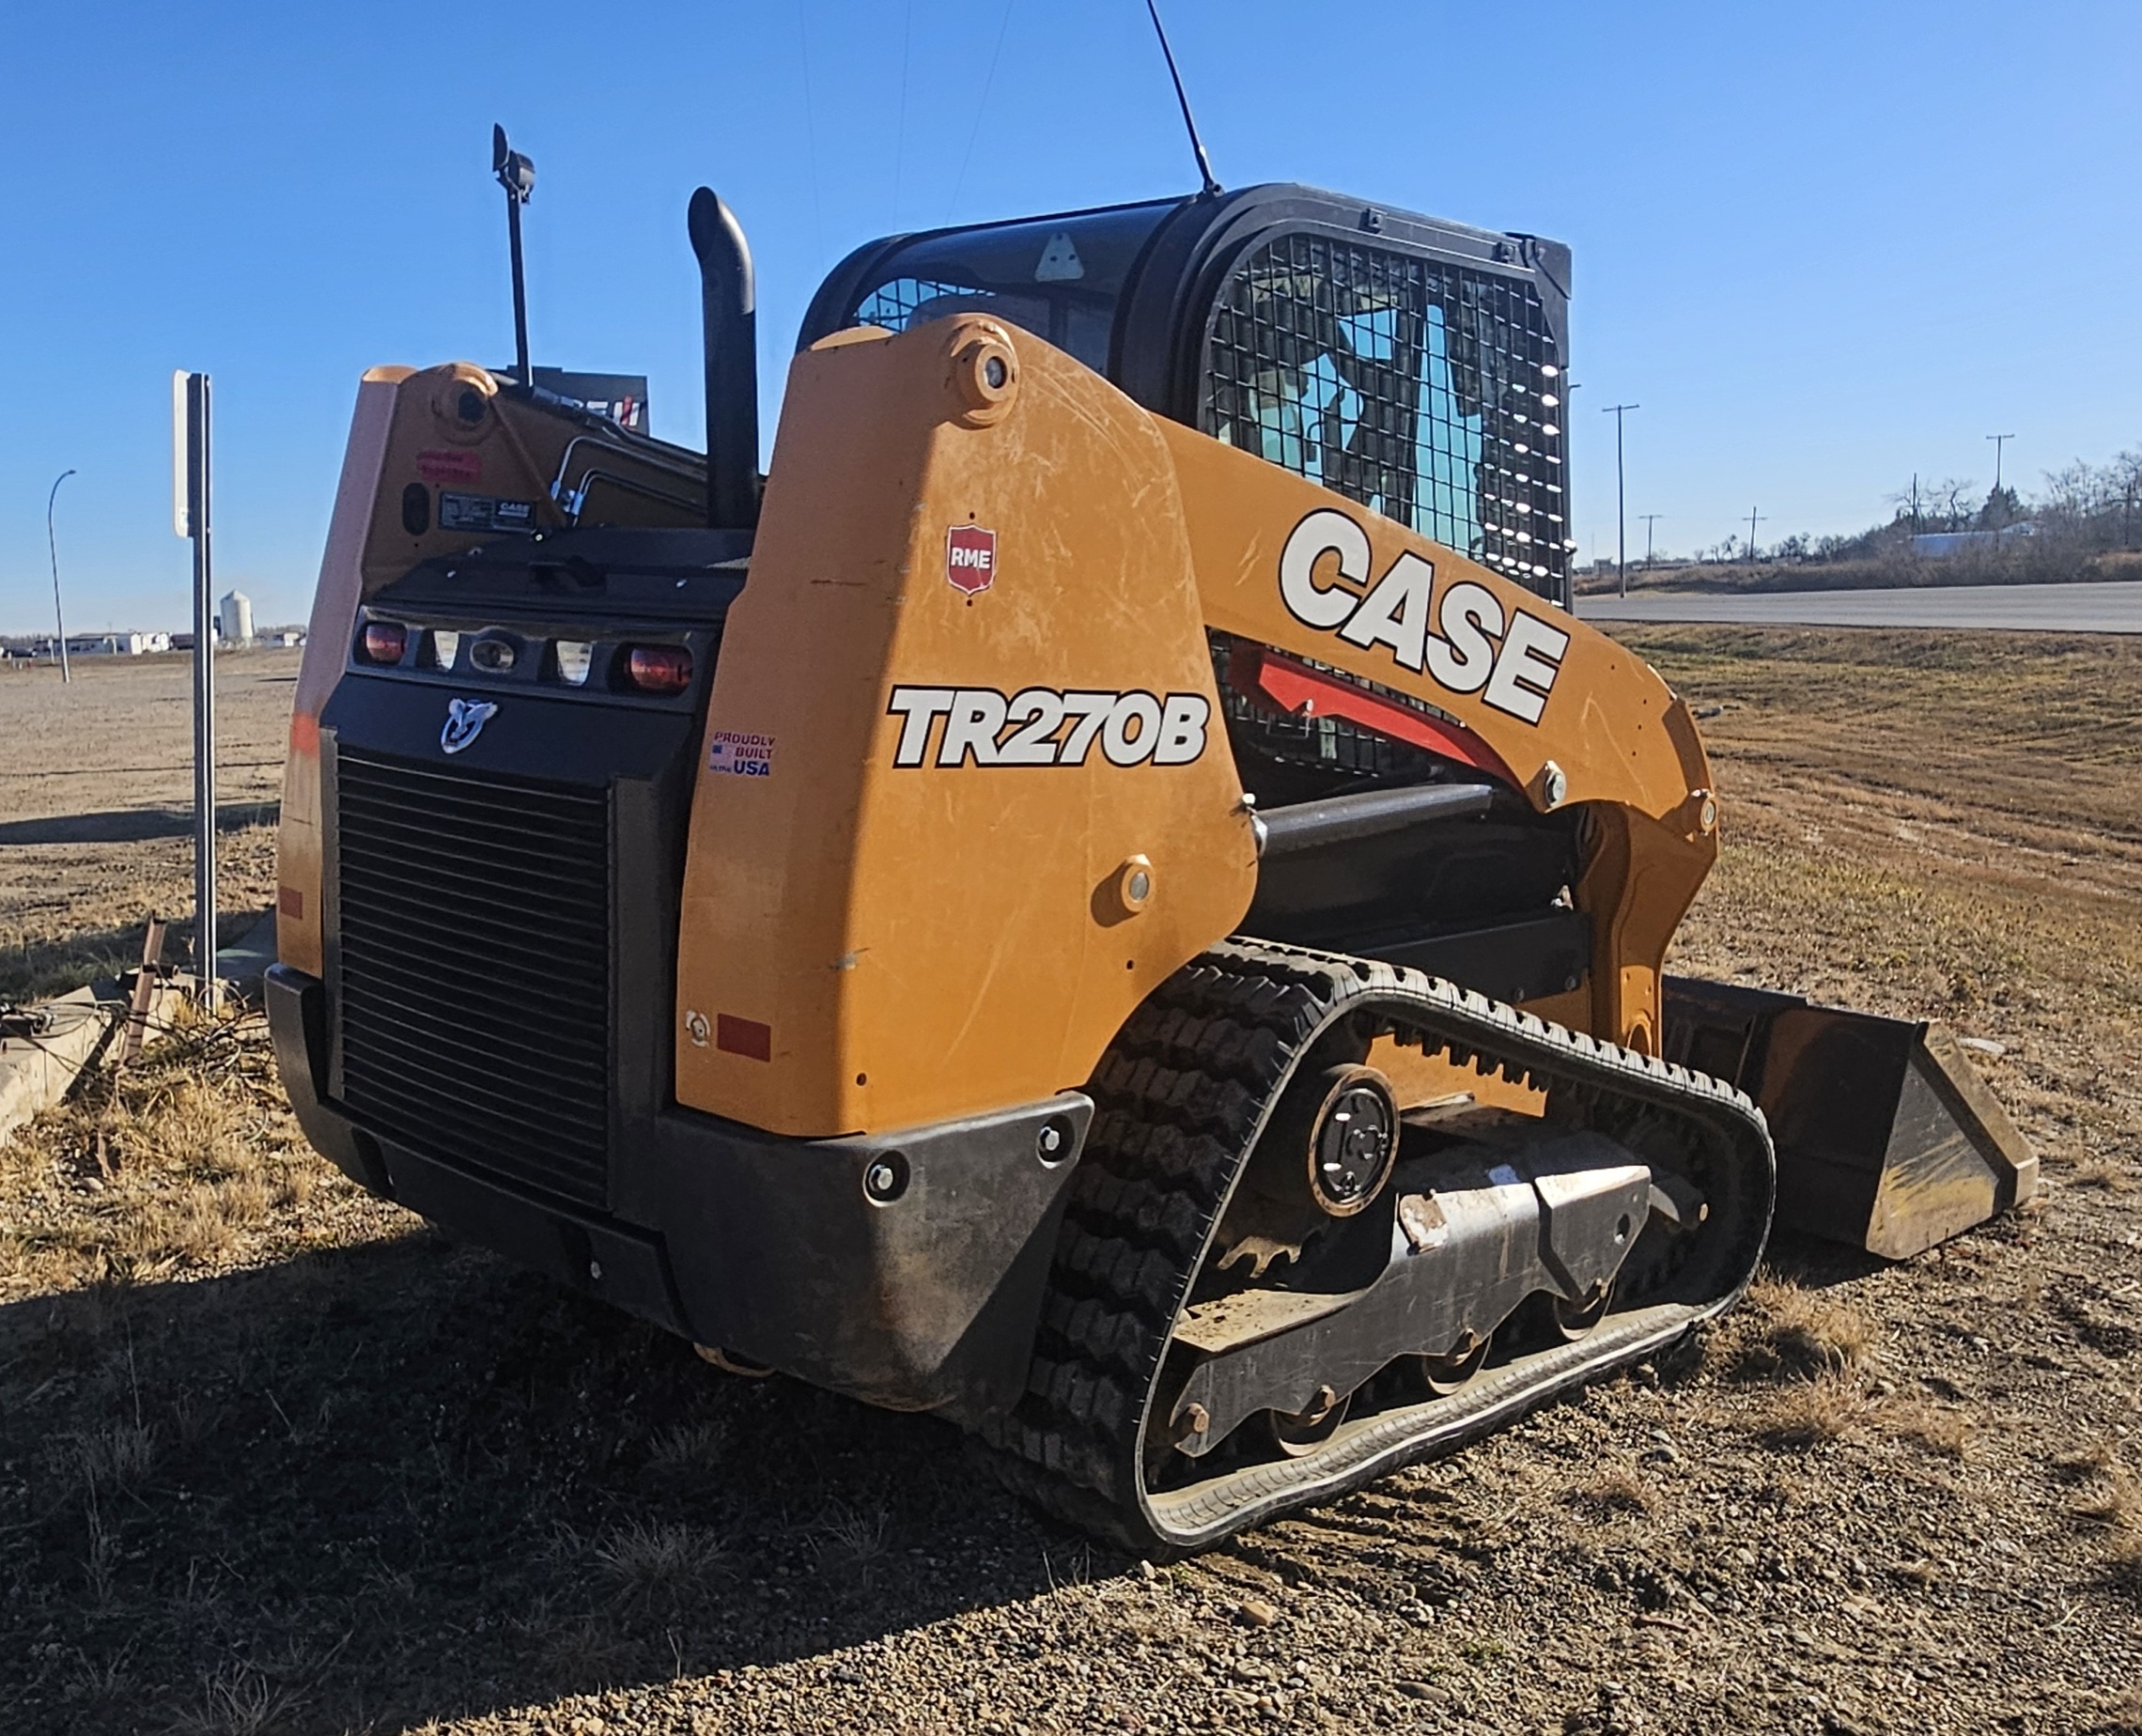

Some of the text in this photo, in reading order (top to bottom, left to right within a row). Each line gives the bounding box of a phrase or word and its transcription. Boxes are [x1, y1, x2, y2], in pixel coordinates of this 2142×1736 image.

[951, 547, 992, 569] RME
[1279, 507, 1571, 728] CASE
[886, 685, 1210, 768] TR270B
[714, 731, 776, 746] PROUDLY
[735, 747, 773, 759] BUILT
[734, 760, 770, 777] USA
